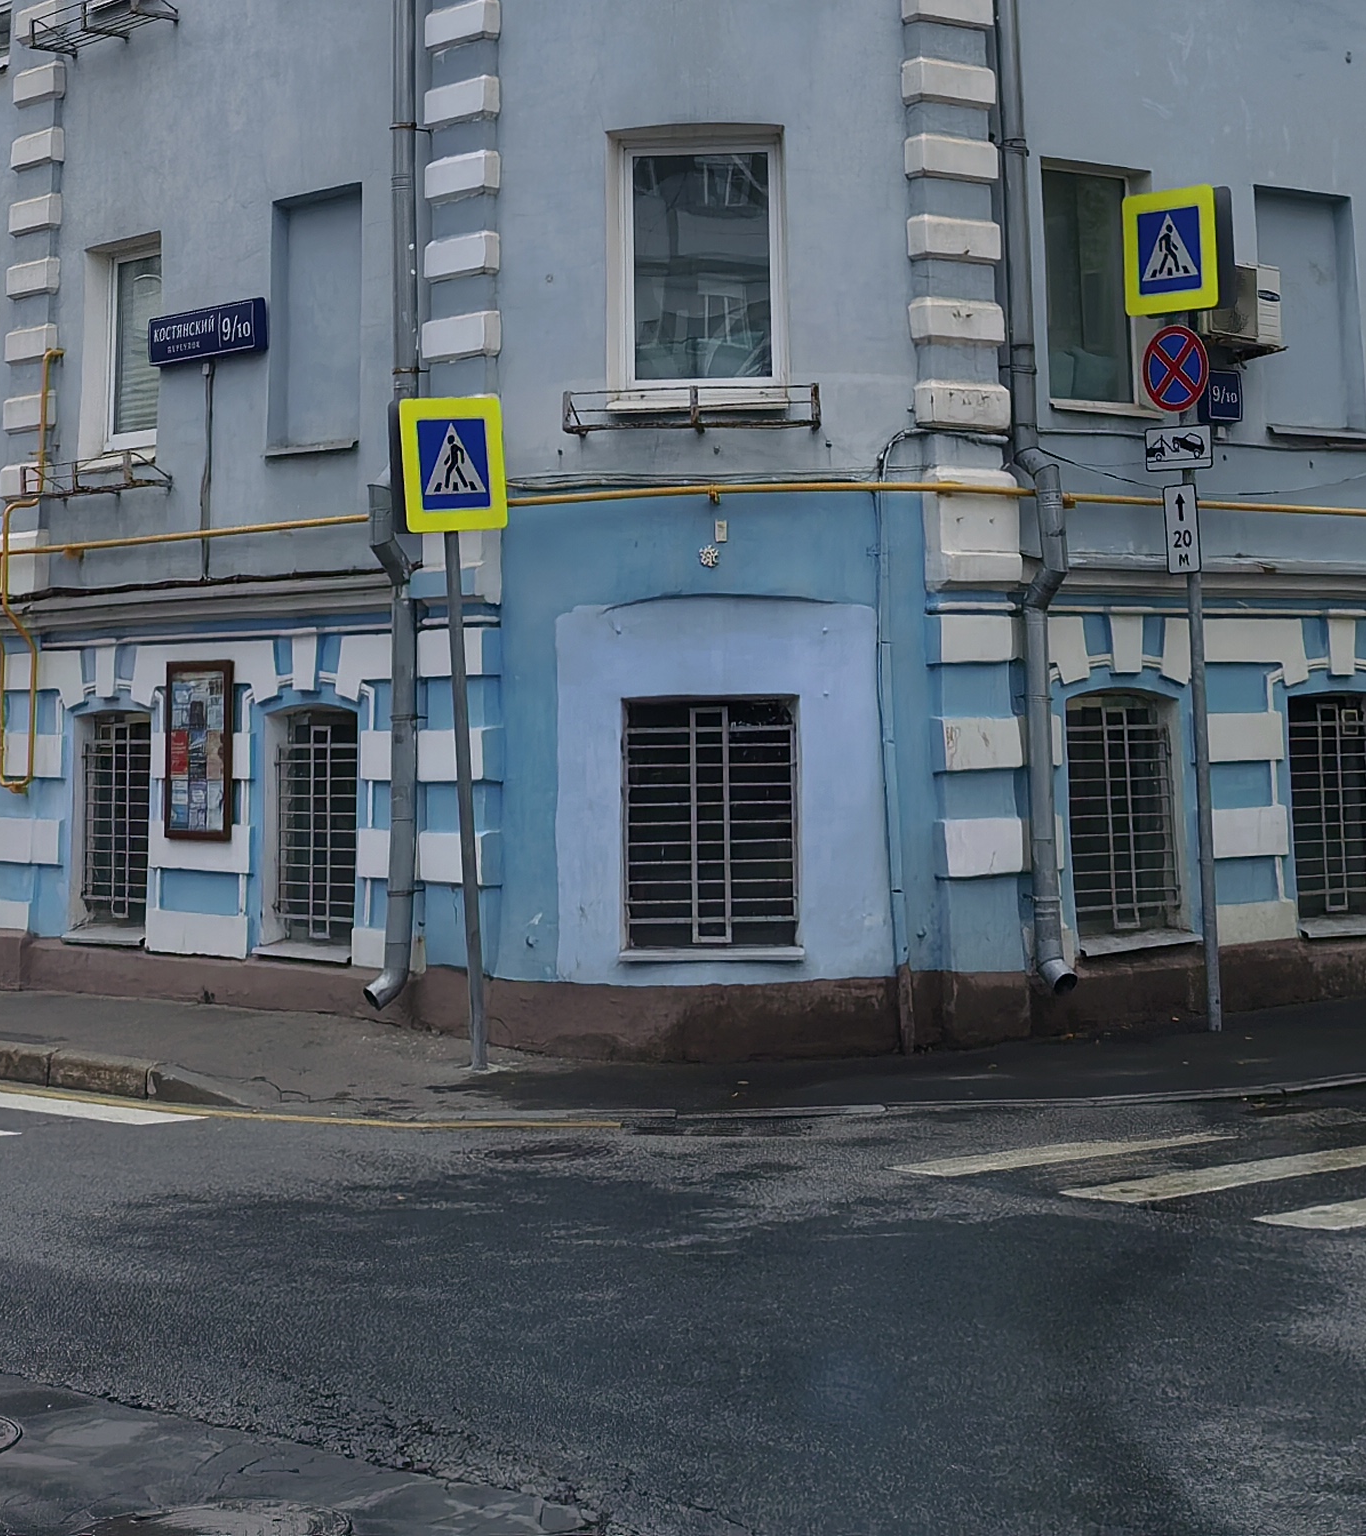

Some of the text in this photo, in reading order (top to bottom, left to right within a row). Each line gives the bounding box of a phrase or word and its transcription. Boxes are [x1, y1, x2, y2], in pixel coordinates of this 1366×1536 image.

[154, 315, 215, 343] КОСТЯНСКИЙ
[222, 315, 251, 342] 9/10
[1212, 385, 1238, 404] 9/10
[1173, 529, 1193, 549] 20
